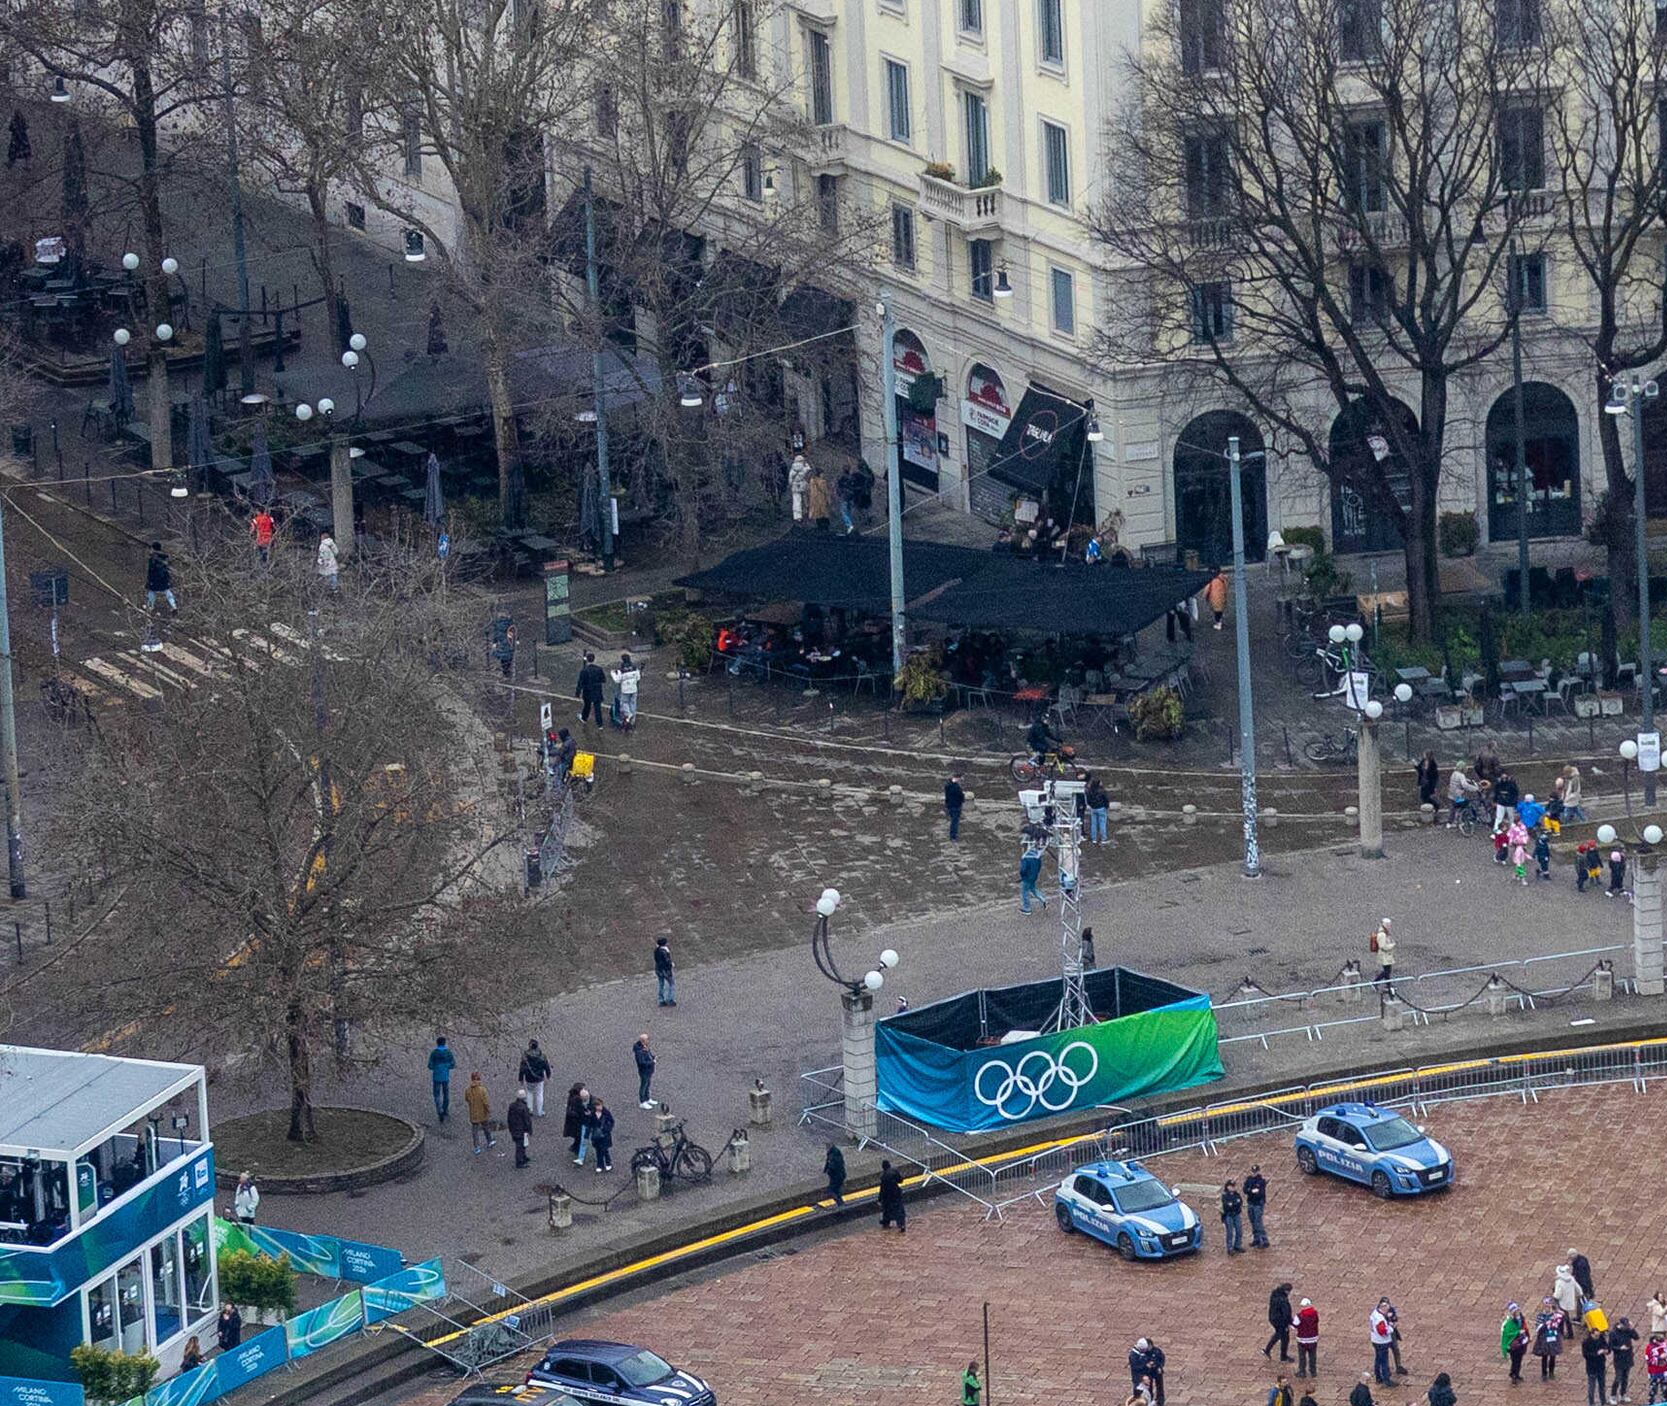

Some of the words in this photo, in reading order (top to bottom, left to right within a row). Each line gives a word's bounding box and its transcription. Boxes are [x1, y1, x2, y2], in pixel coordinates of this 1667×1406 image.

[1318, 1149, 1364, 1172] POLIZIA
[1072, 1208, 1110, 1233] POLIZIA
[12, 1386, 46, 1396] MILANO
